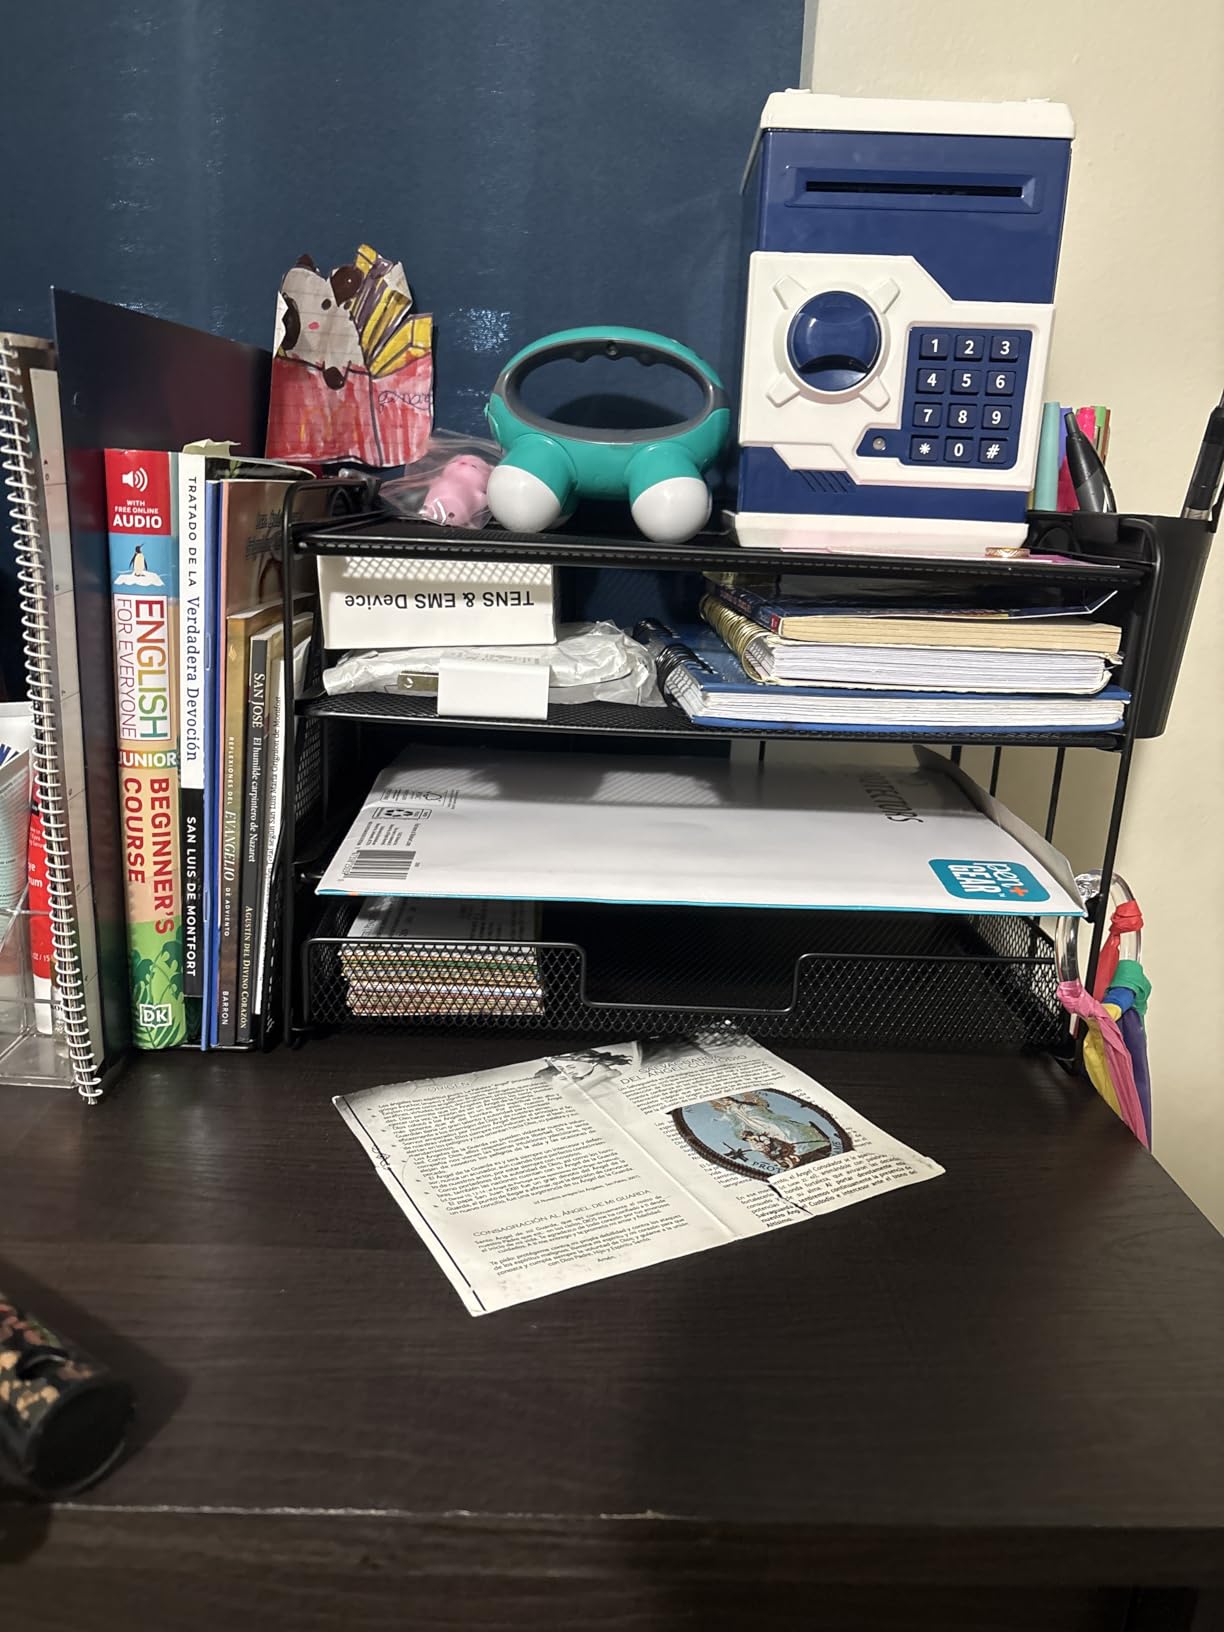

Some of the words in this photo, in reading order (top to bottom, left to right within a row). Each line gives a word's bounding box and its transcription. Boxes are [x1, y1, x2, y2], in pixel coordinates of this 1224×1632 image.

[930, 338, 940, 353] 1
[964, 340, 974, 355] 2
[1000, 341, 1010, 356] 3
[926, 373, 938, 388] 4
[961, 373, 972, 388] 5
[996, 374, 1006, 390] 6
[923, 409, 933, 423] 7
[958, 410, 968, 424] 8
[992, 410, 1002, 426] 9
[954, 443, 964, 458] 0
[112, 513, 163, 529] AUDIO
[114, 506, 132, 514] FREE
[132, 506, 159, 514] ONLINE
[188, 476, 198, 541] TRATADO
[188, 547, 198, 564] DE
[188, 570, 198, 588] LA
[344, 594, 408, 611] Device
[414, 592, 456, 609] EMS
[462, 592, 476, 608] &
[482, 590, 534, 608] TENS
[118, 598, 133, 635] FOR
[186, 596, 201, 682] Verdadera
[136, 599, 168, 739] ENGLISH
[118, 640, 138, 739] EVERYONE
[254, 672, 266, 699] SAN
[186, 687, 201, 761] Devoción
[251, 700, 266, 728] JOSÉ
[253, 737, 262, 746] El
[118, 750, 178, 769] JUNIOR
[252, 746, 262, 780] humilde
[249, 780, 260, 821] carpintero
[124, 776, 146, 884] COURSE
[186, 816, 197, 844] SAN
[250, 822, 259, 832] de
[150, 776, 174, 934] BEGINNER'S
[224, 810, 237, 881] EVANGELIO
[248, 832, 258, 862] Nazaret
[186, 848, 197, 878] LUIS
[186, 883, 197, 901] DE
[225, 887, 231, 898] DE
[948, 864, 1002, 894] GEAR
[244, 906, 254, 942] AGUSTÍN
[186, 906, 197, 976] MONTFORT
[243, 943, 252, 958] DEL
[242, 960, 252, 990] DIVINO
[143, 1006, 169, 1024] DK
[222, 990, 230, 1025] BARRON
[240, 990, 251, 1029] CORAZÓN
[620, 1074, 645, 1085] DEL
[472, 1216, 548, 1237] CONSAGRACIÓN
[548, 1212, 562, 1220] AL
[562, 1204, 592, 1217] ÁNGEL
[616, 1190, 651, 1202] GUARDA
